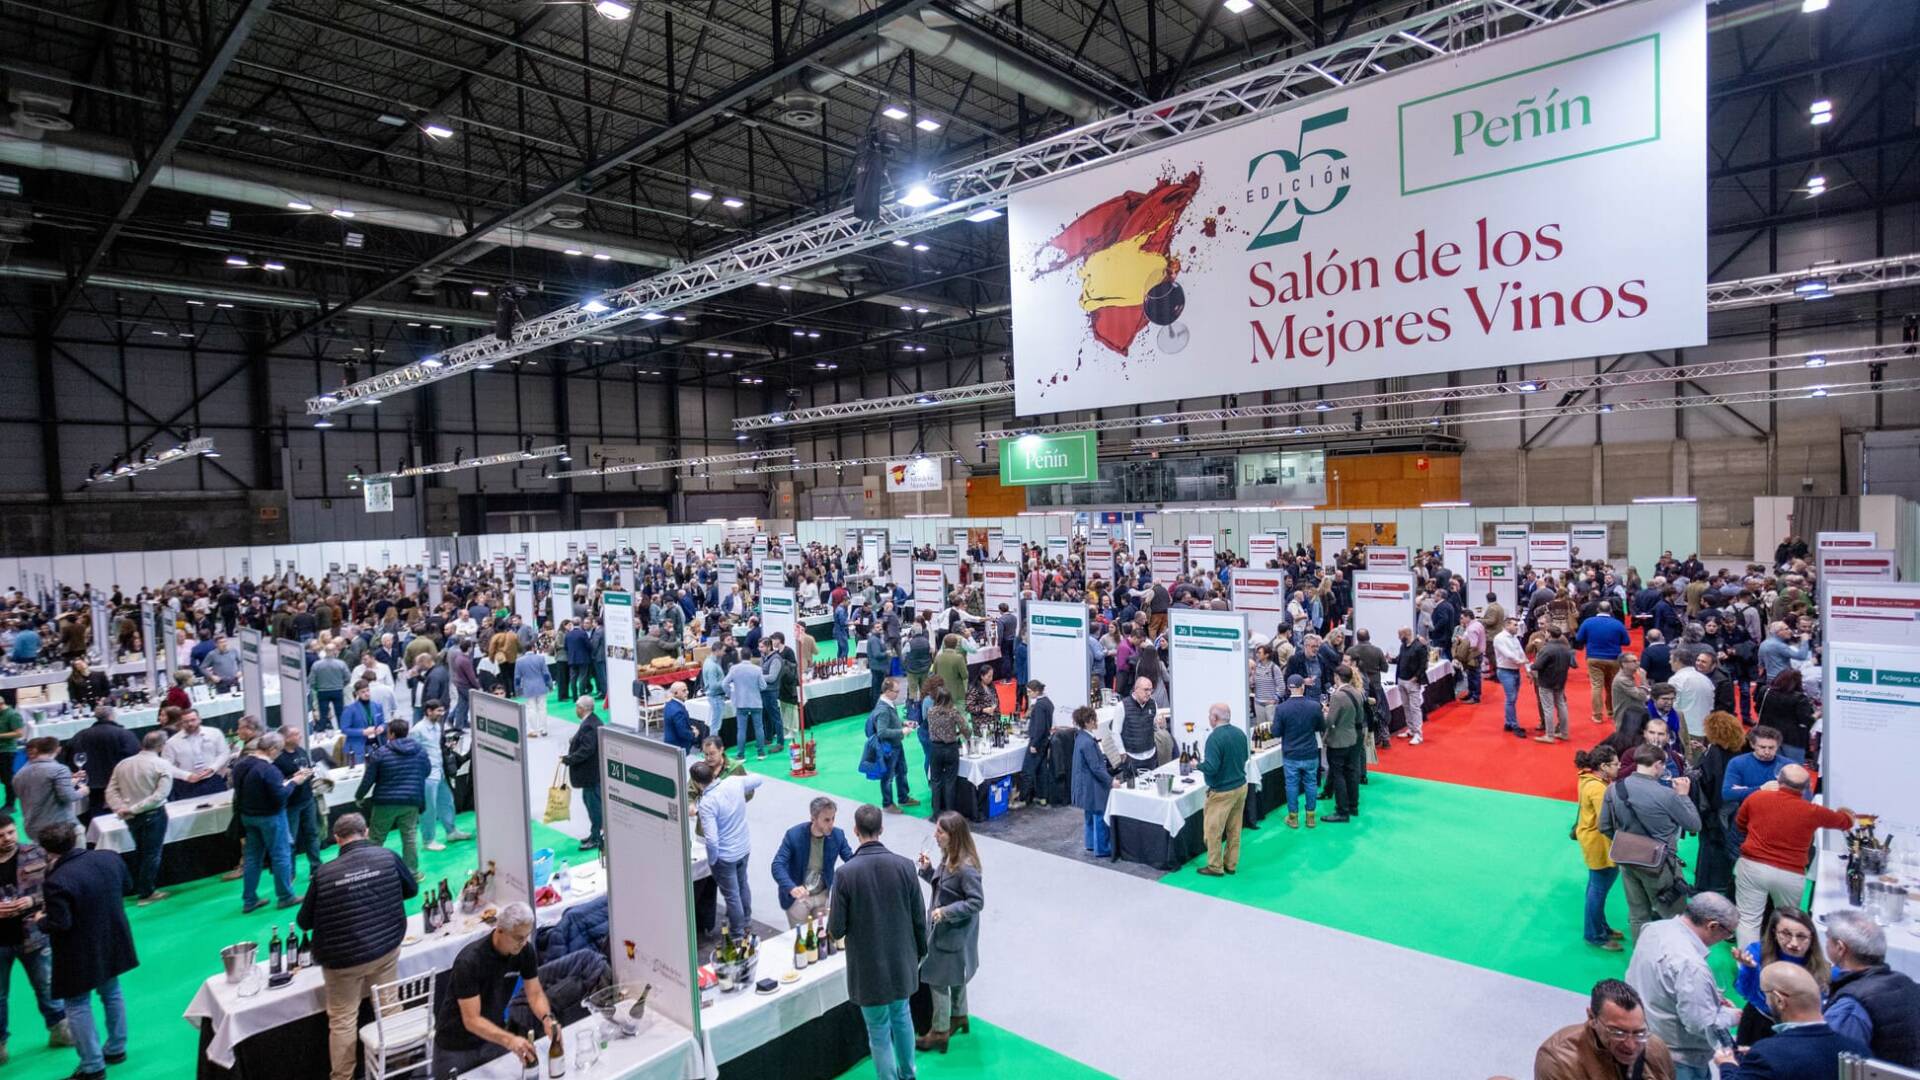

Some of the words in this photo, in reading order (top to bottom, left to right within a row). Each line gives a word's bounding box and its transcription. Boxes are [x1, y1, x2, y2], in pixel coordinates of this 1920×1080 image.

[1453, 87, 1592, 156] Peñín
[1246, 107, 1351, 251] 25
[1246, 165, 1350, 203] EDICIÓN
[1249, 248, 1380, 308] Salón
[1395, 229, 1462, 283] de
[1476, 217, 1564, 271] los
[1250, 308, 1451, 367] Mejores
[1463, 279, 1649, 335] Vinos
[1025, 448, 1068, 470] Peñín
[1848, 669, 1859, 681] 8
[1880, 674, 1912, 684] Adegas
[610, 762, 620, 779] 24
